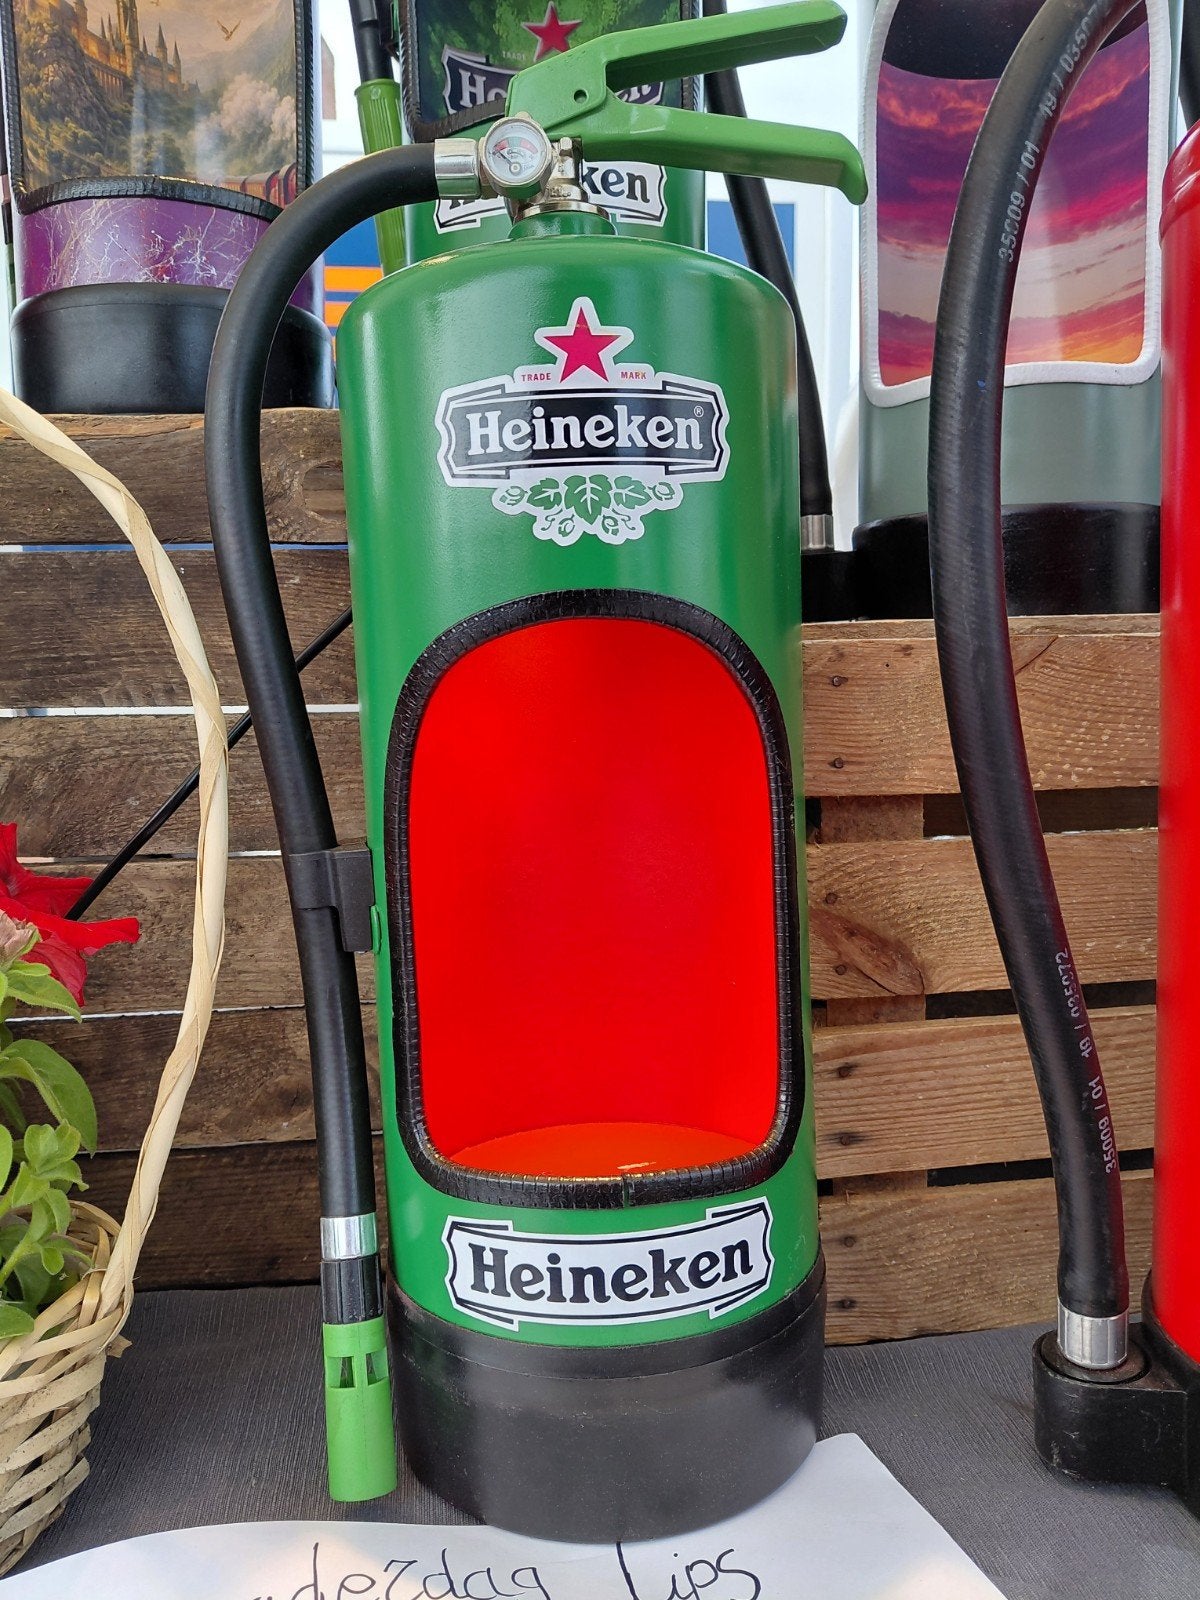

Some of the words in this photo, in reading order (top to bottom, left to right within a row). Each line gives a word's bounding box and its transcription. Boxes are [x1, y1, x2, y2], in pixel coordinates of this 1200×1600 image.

[1020, 140, 1040, 170] 01
[520, 371, 552, 383] TRADE
[620, 370, 648, 381] MARK
[465, 404, 704, 457] Heineken
[1088, 1075, 1104, 1100] 01
[1098, 1117, 1118, 1174] 35009
[467, 1239, 754, 1304] Heineken
